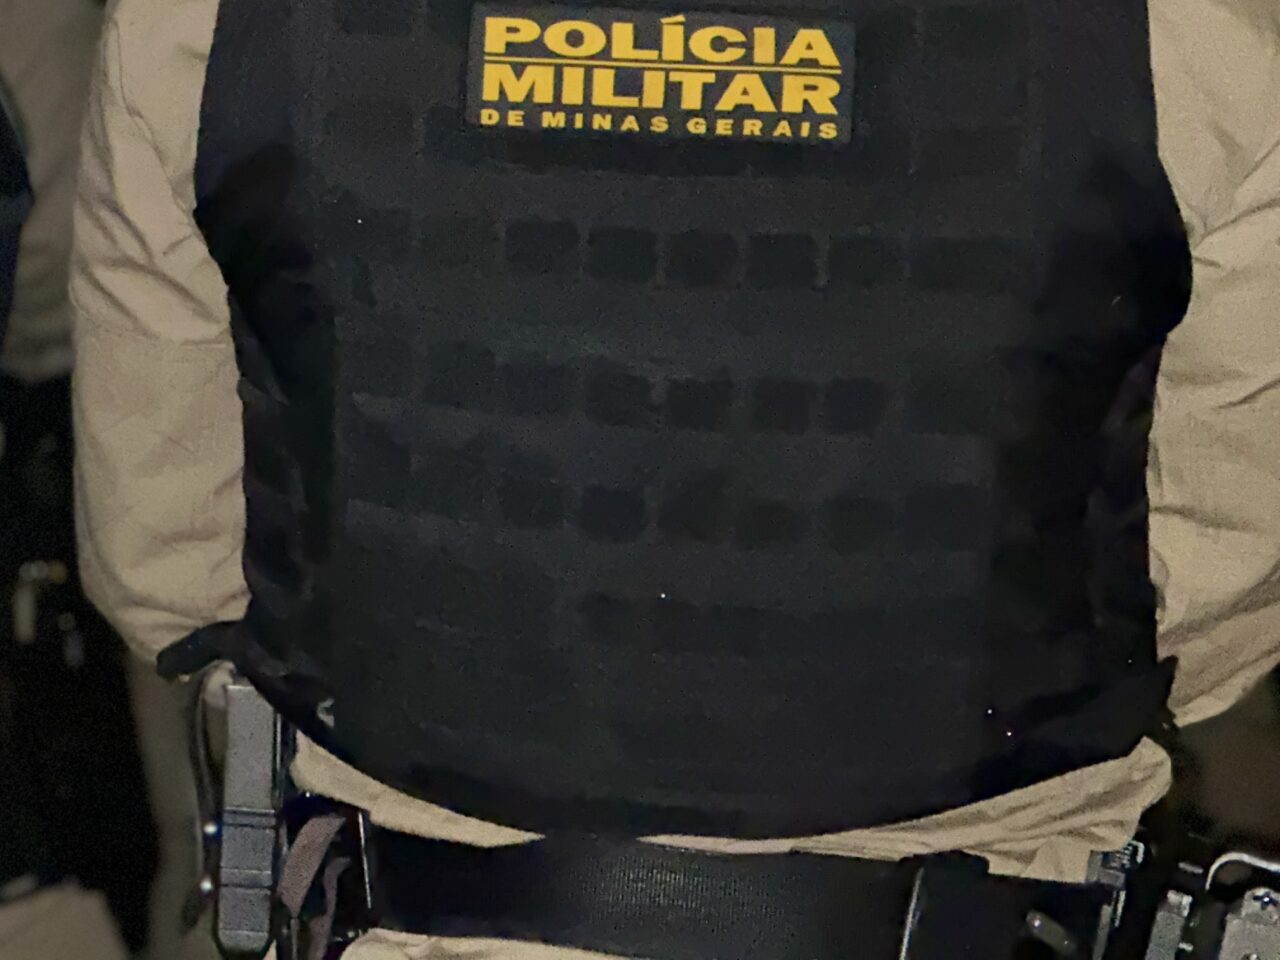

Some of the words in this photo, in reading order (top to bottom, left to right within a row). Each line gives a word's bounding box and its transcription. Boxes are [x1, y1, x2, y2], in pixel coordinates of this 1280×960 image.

[484, 14, 841, 67] POLÍCIA
[482, 63, 841, 115] MILITAR
[480, 108, 525, 127] DE
[541, 110, 669, 133] MINAS
[686, 119, 838, 139] GERAIS
